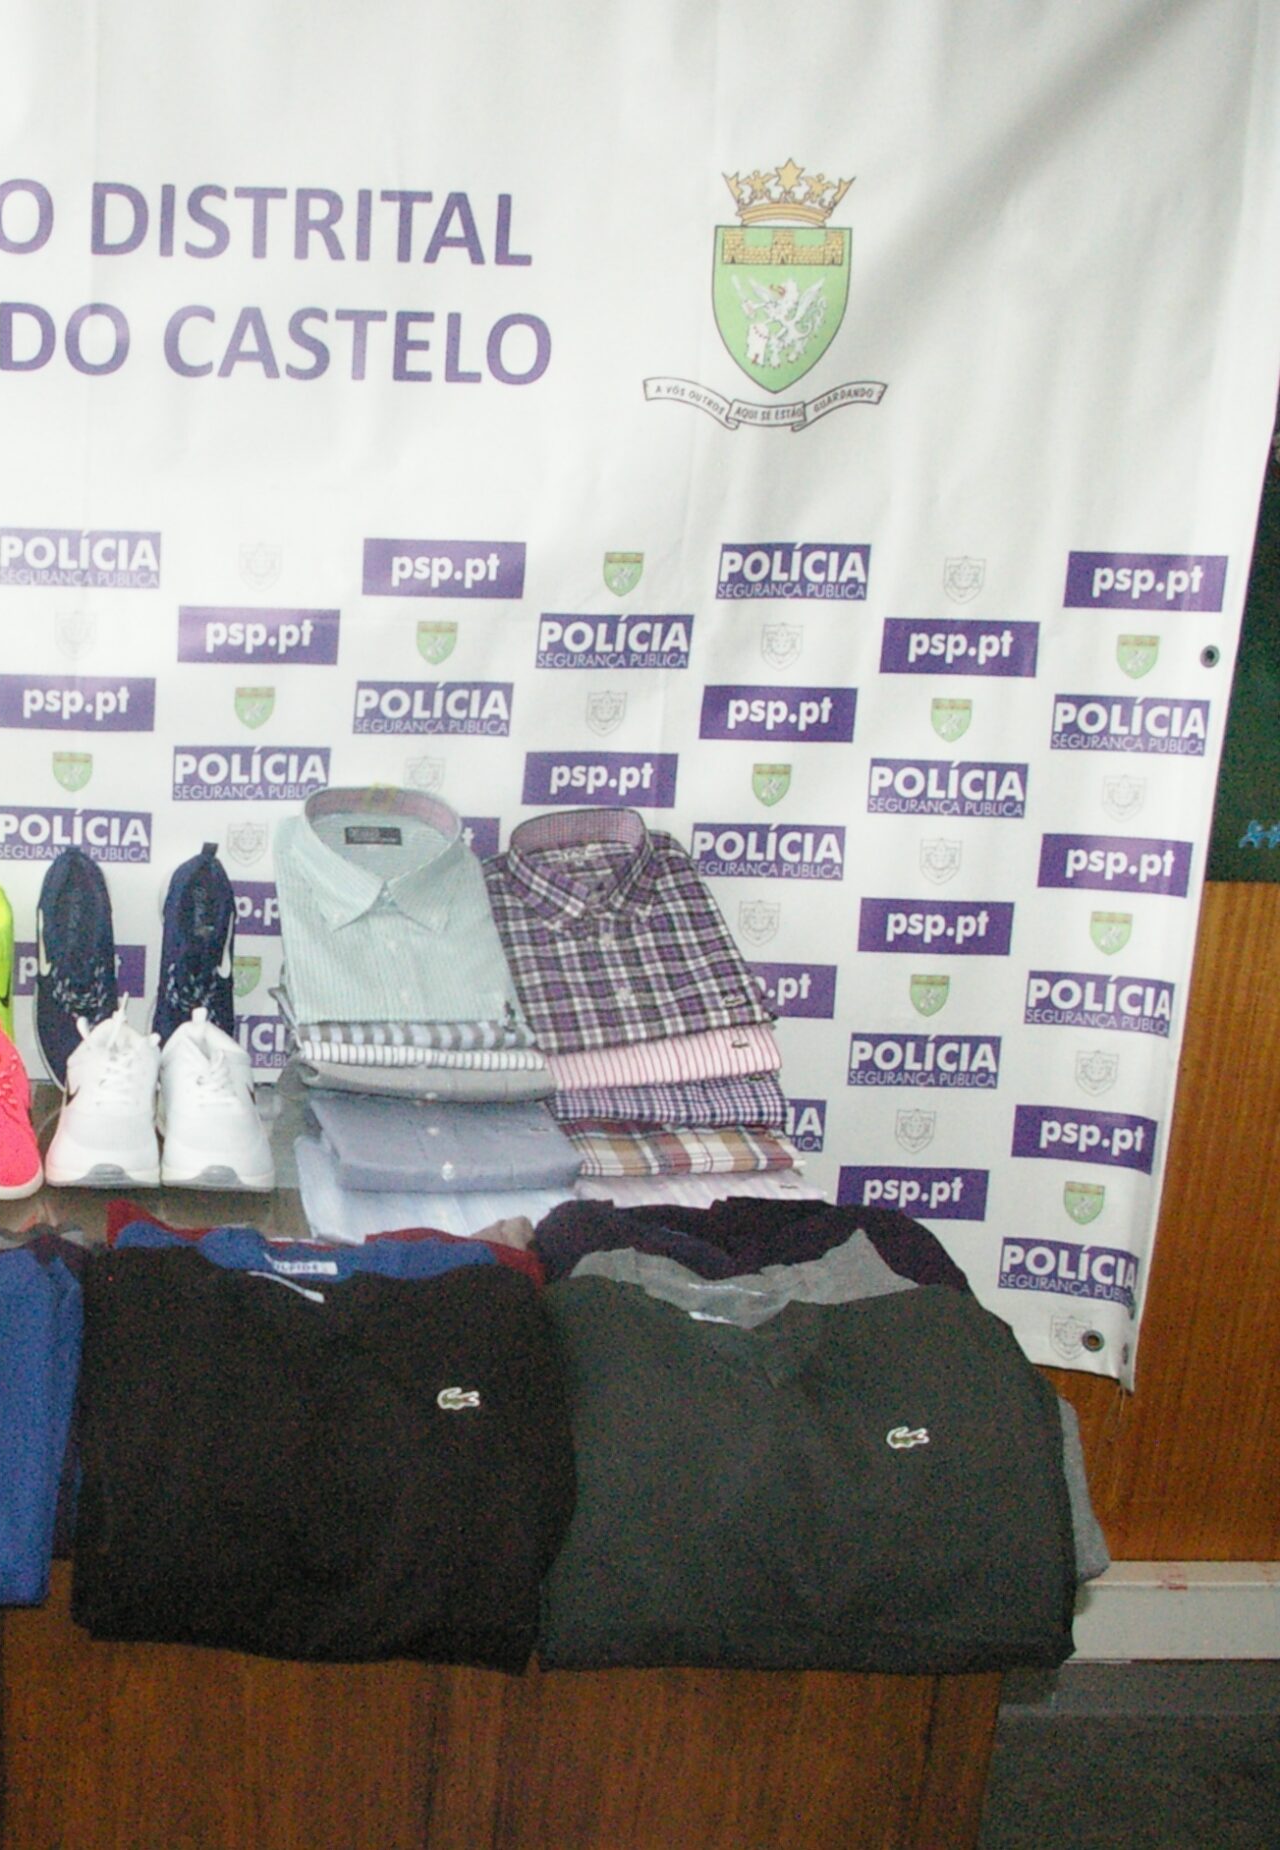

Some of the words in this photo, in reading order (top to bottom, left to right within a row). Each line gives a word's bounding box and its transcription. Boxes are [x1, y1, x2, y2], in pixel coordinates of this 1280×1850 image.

[90, 182, 530, 267] DISTRITAL
[0, 302, 129, 376] DO
[164, 305, 551, 386] CASTELO
[1, 530, 158, 571] POLÍCIA
[719, 544, 866, 583] POLÍCIA
[1, 569, 94, 585] SEGURANÇA
[391, 553, 500, 588] psp.pt
[1092, 564, 1203, 600] psp.pt
[717, 583, 806, 598] SEGURANÇA
[205, 618, 313, 654] psp.pt
[539, 614, 688, 652] POLÍCIA
[908, 630, 1013, 665] psp.pt
[537, 652, 627, 667] SEGURANÇA
[24, 686, 129, 720] psp.pt
[356, 682, 508, 719] POLÍCIA
[727, 697, 832, 730] psp.pt
[355, 719, 446, 734] SEGURANÇA
[1054, 698, 1203, 739] POLÍCIA
[1052, 734, 1142, 751] SEGURANÇA
[175, 747, 326, 785] POLÍCIA
[550, 763, 653, 796] psp.pt
[870, 760, 1023, 801] POLÍCIA
[175, 786, 265, 800] SEGURANÇA
[870, 797, 961, 814] SEGURANÇA
[694, 825, 841, 863] POLÍCIA
[1066, 849, 1174, 883] psp.pt
[887, 911, 988, 944] psp.pt
[1028, 975, 1170, 1021] POLÍCIA
[1026, 1009, 1117, 1028] SEGURANÇA
[851, 1034, 996, 1072] POLÍCIA
[850, 1071, 937, 1086] SEGURANÇA
[1040, 1121, 1143, 1156] psp.pt
[863, 1177, 963, 1208] psp.pt
[1000, 1272, 1090, 1296] SEGURANÇA
[1002, 1244, 1136, 1290] POLÍCIA
